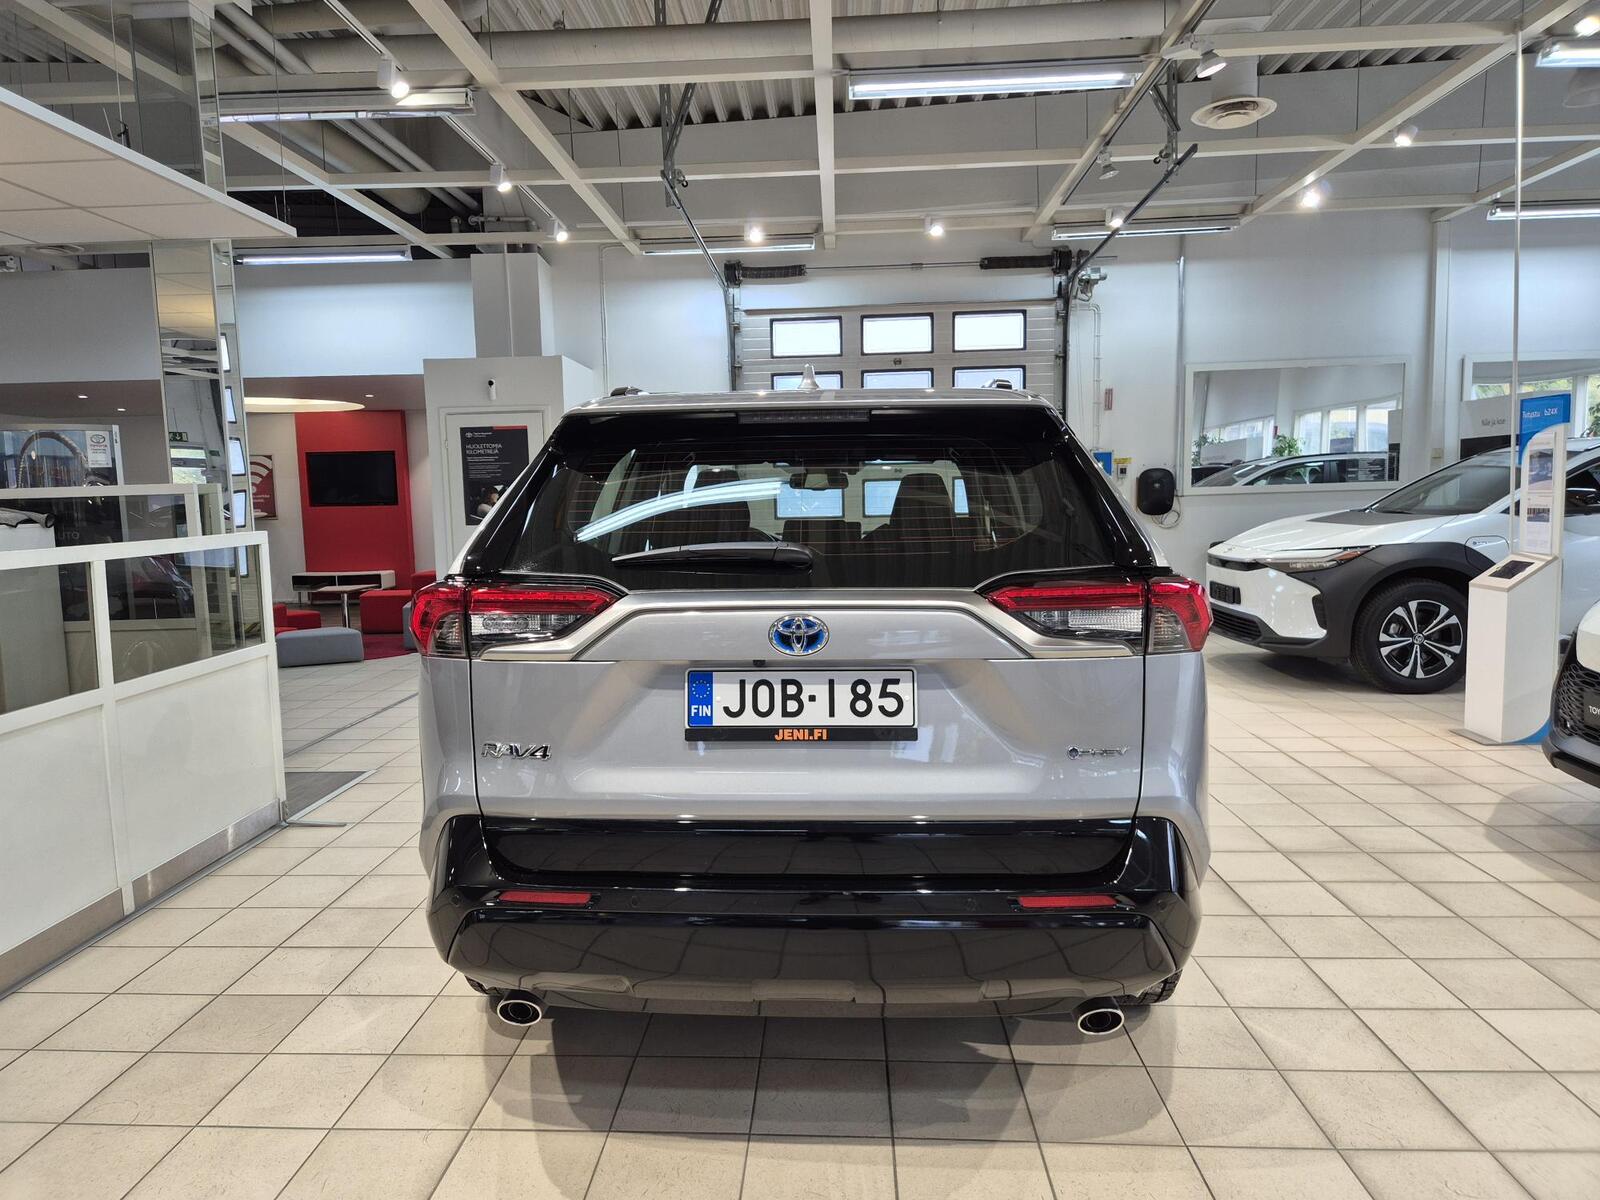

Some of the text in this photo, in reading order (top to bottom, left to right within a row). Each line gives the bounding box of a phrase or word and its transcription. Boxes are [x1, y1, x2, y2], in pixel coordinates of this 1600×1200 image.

[691, 678, 904, 718] FIN JOB-185
[774, 728, 829, 741] JENI.FI
[481, 742, 552, 760] RAV4
